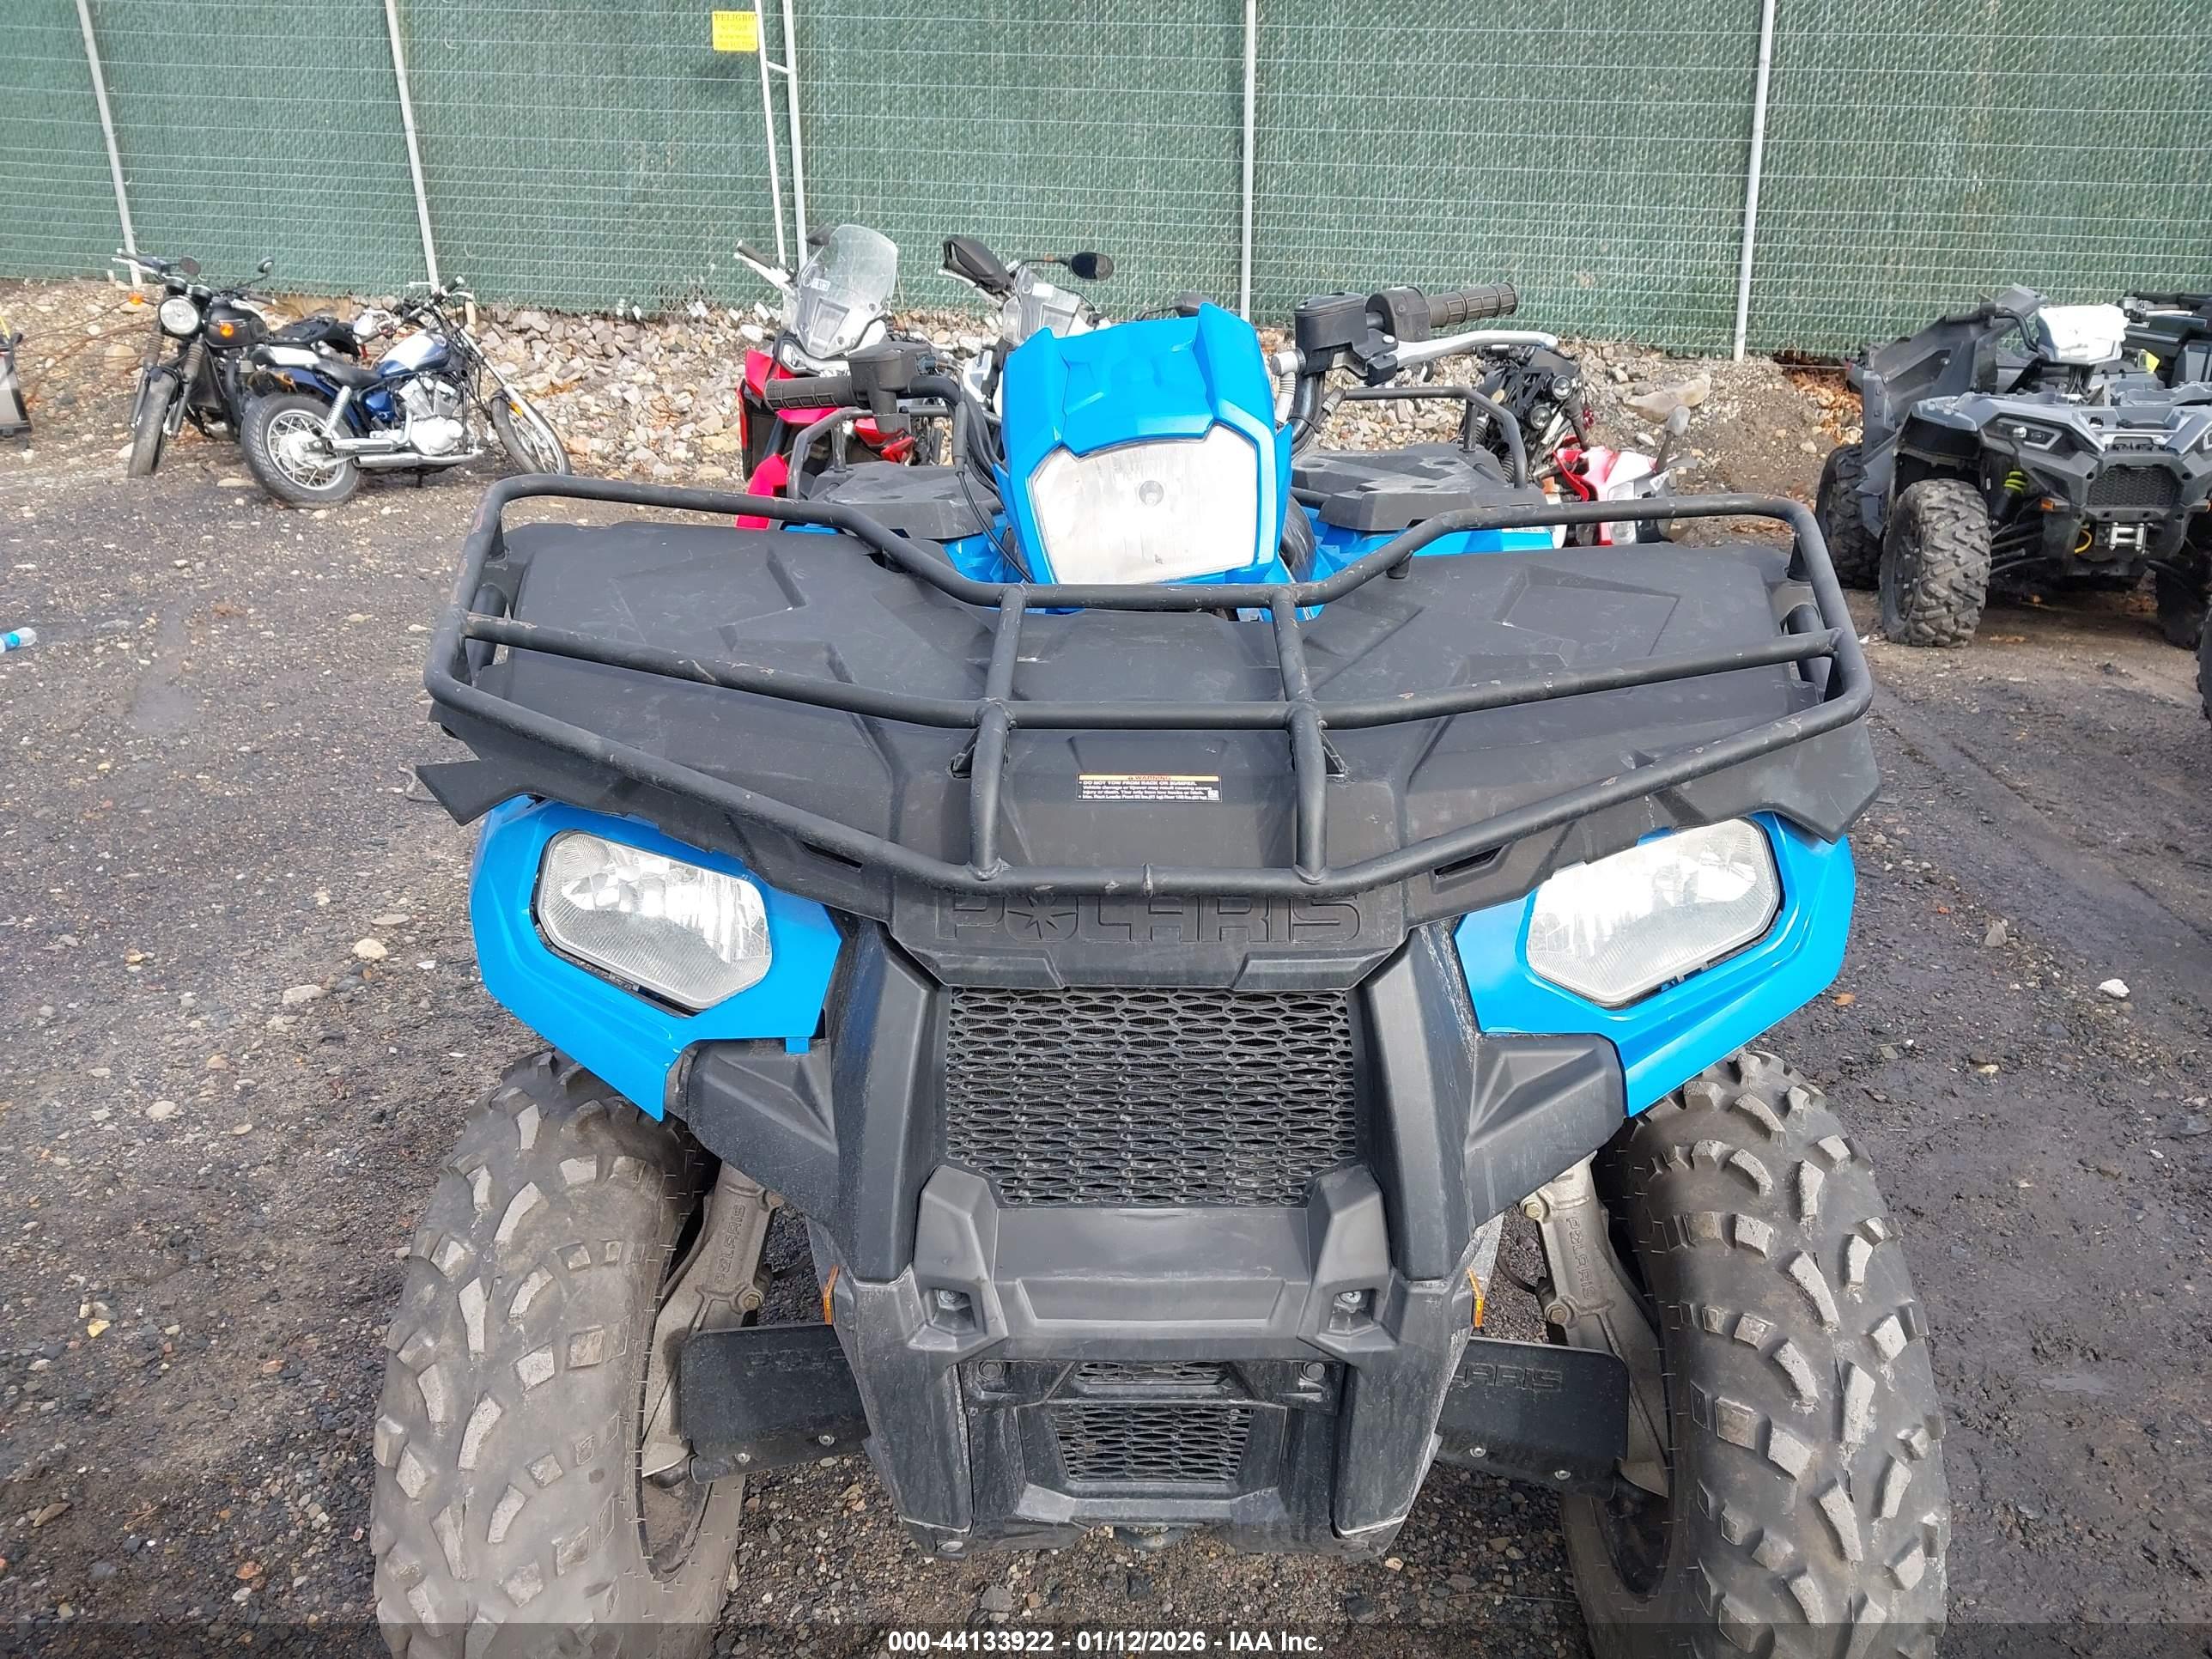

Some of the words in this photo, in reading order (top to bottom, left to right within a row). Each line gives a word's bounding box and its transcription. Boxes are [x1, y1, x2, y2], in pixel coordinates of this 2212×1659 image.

[936, 896, 1360, 944] POLARIS
[714, 1204, 746, 1285] POLARIS
[1566, 1216, 1595, 1300] POLARIS
